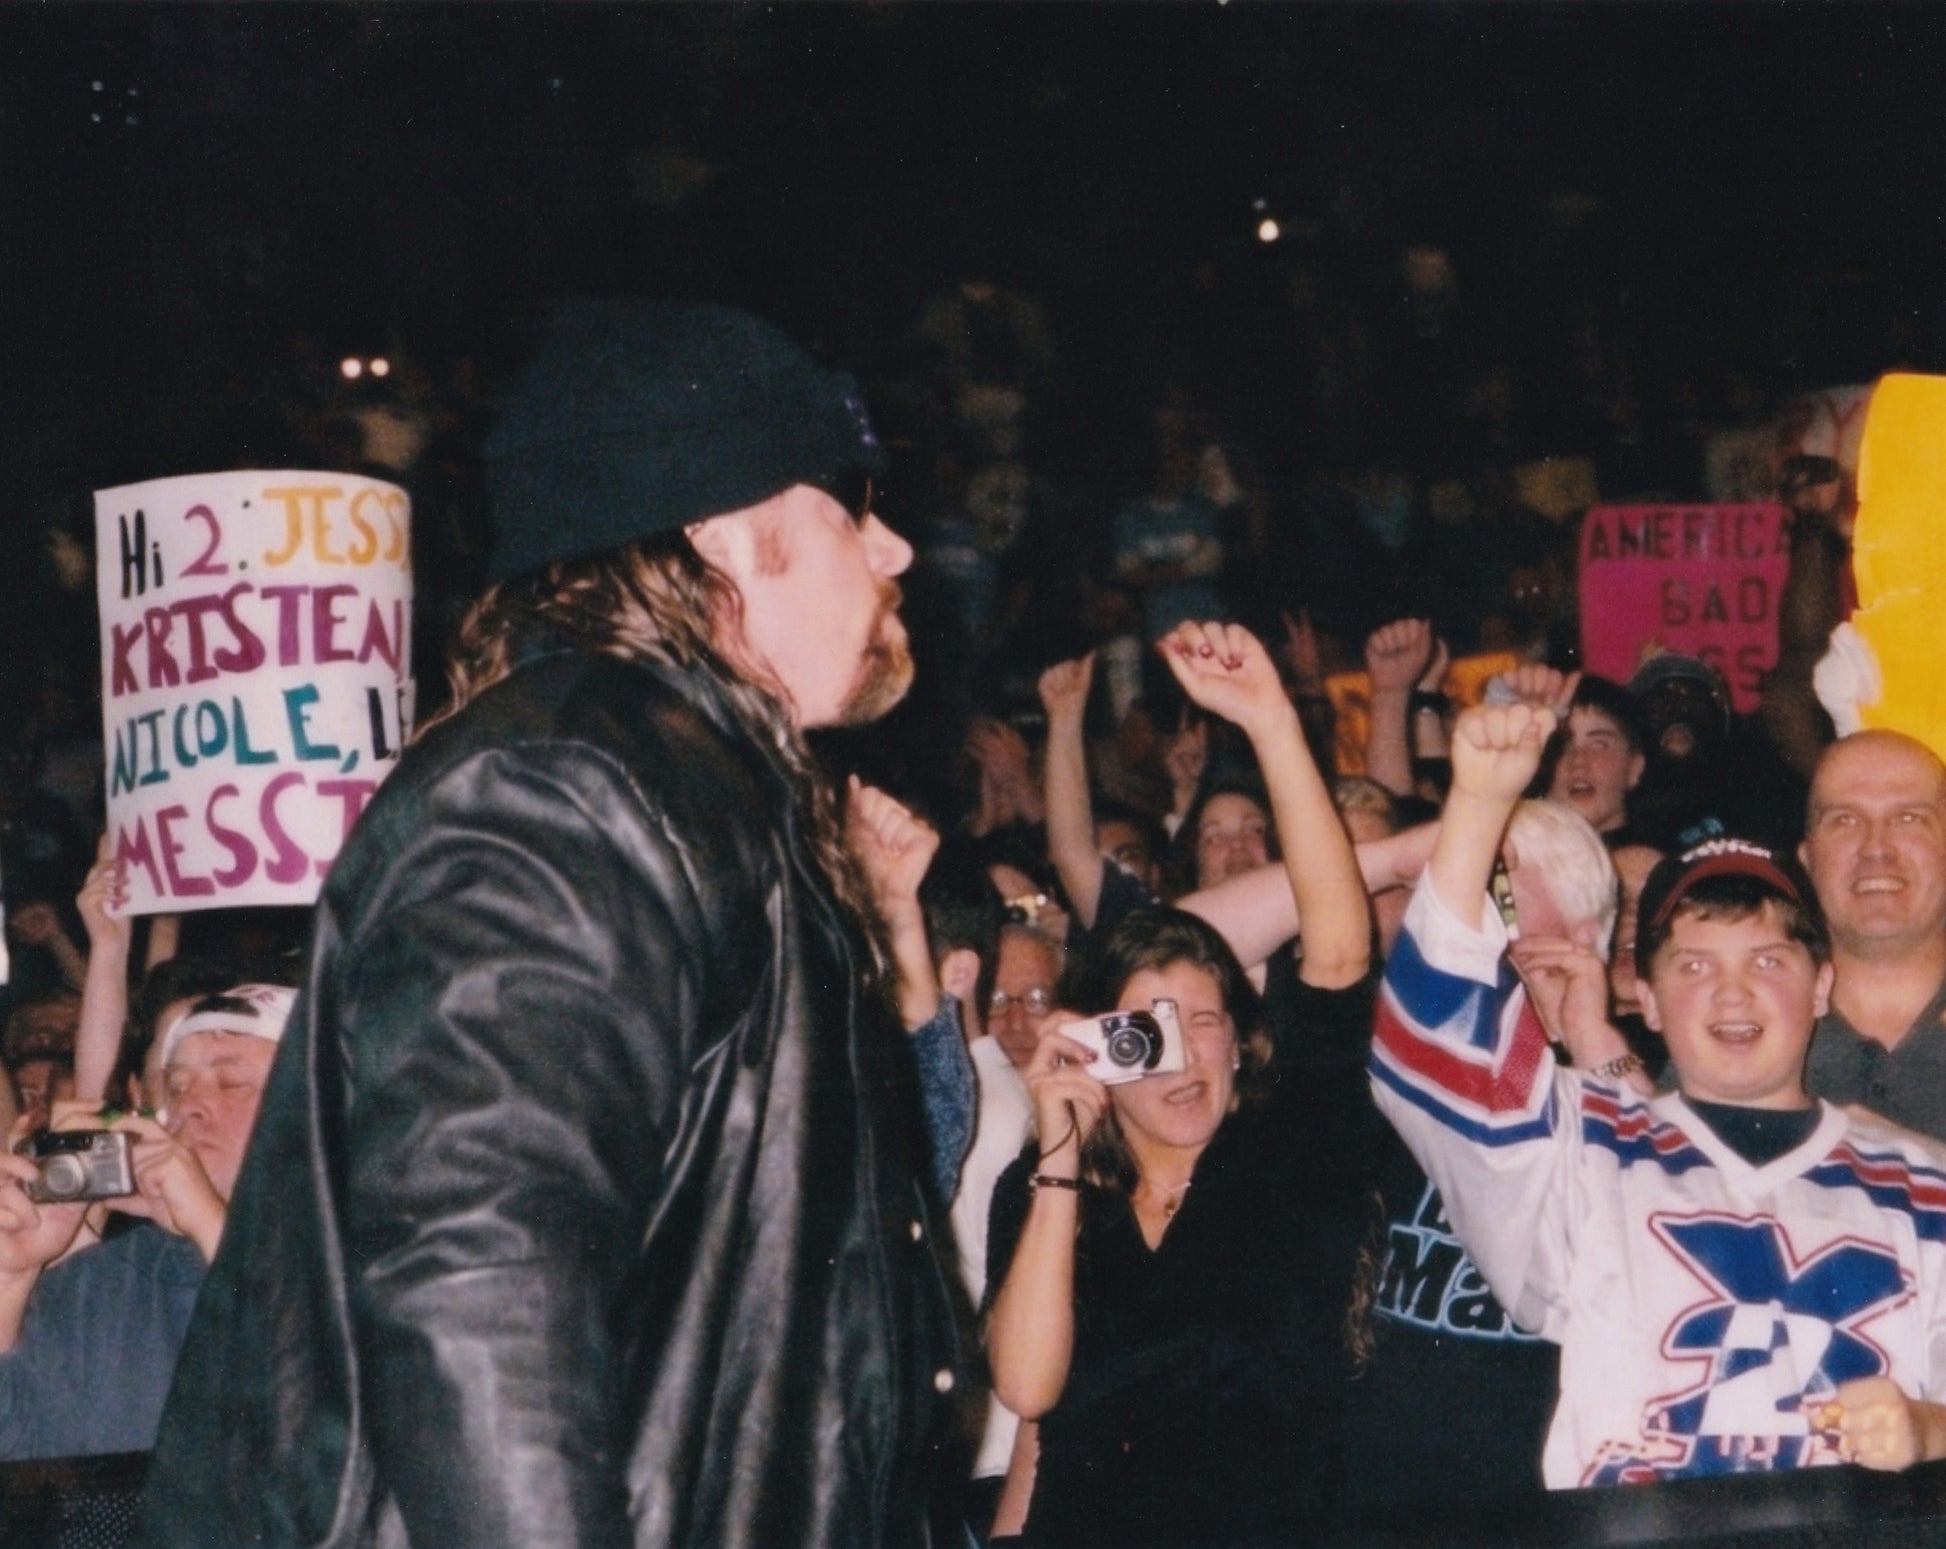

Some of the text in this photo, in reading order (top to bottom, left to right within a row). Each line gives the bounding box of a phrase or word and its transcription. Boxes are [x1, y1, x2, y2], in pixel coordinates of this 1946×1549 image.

[119, 509, 164, 598] Hi
[112, 582, 403, 697] KRISTEN
[112, 683, 360, 798] NICOLE,
